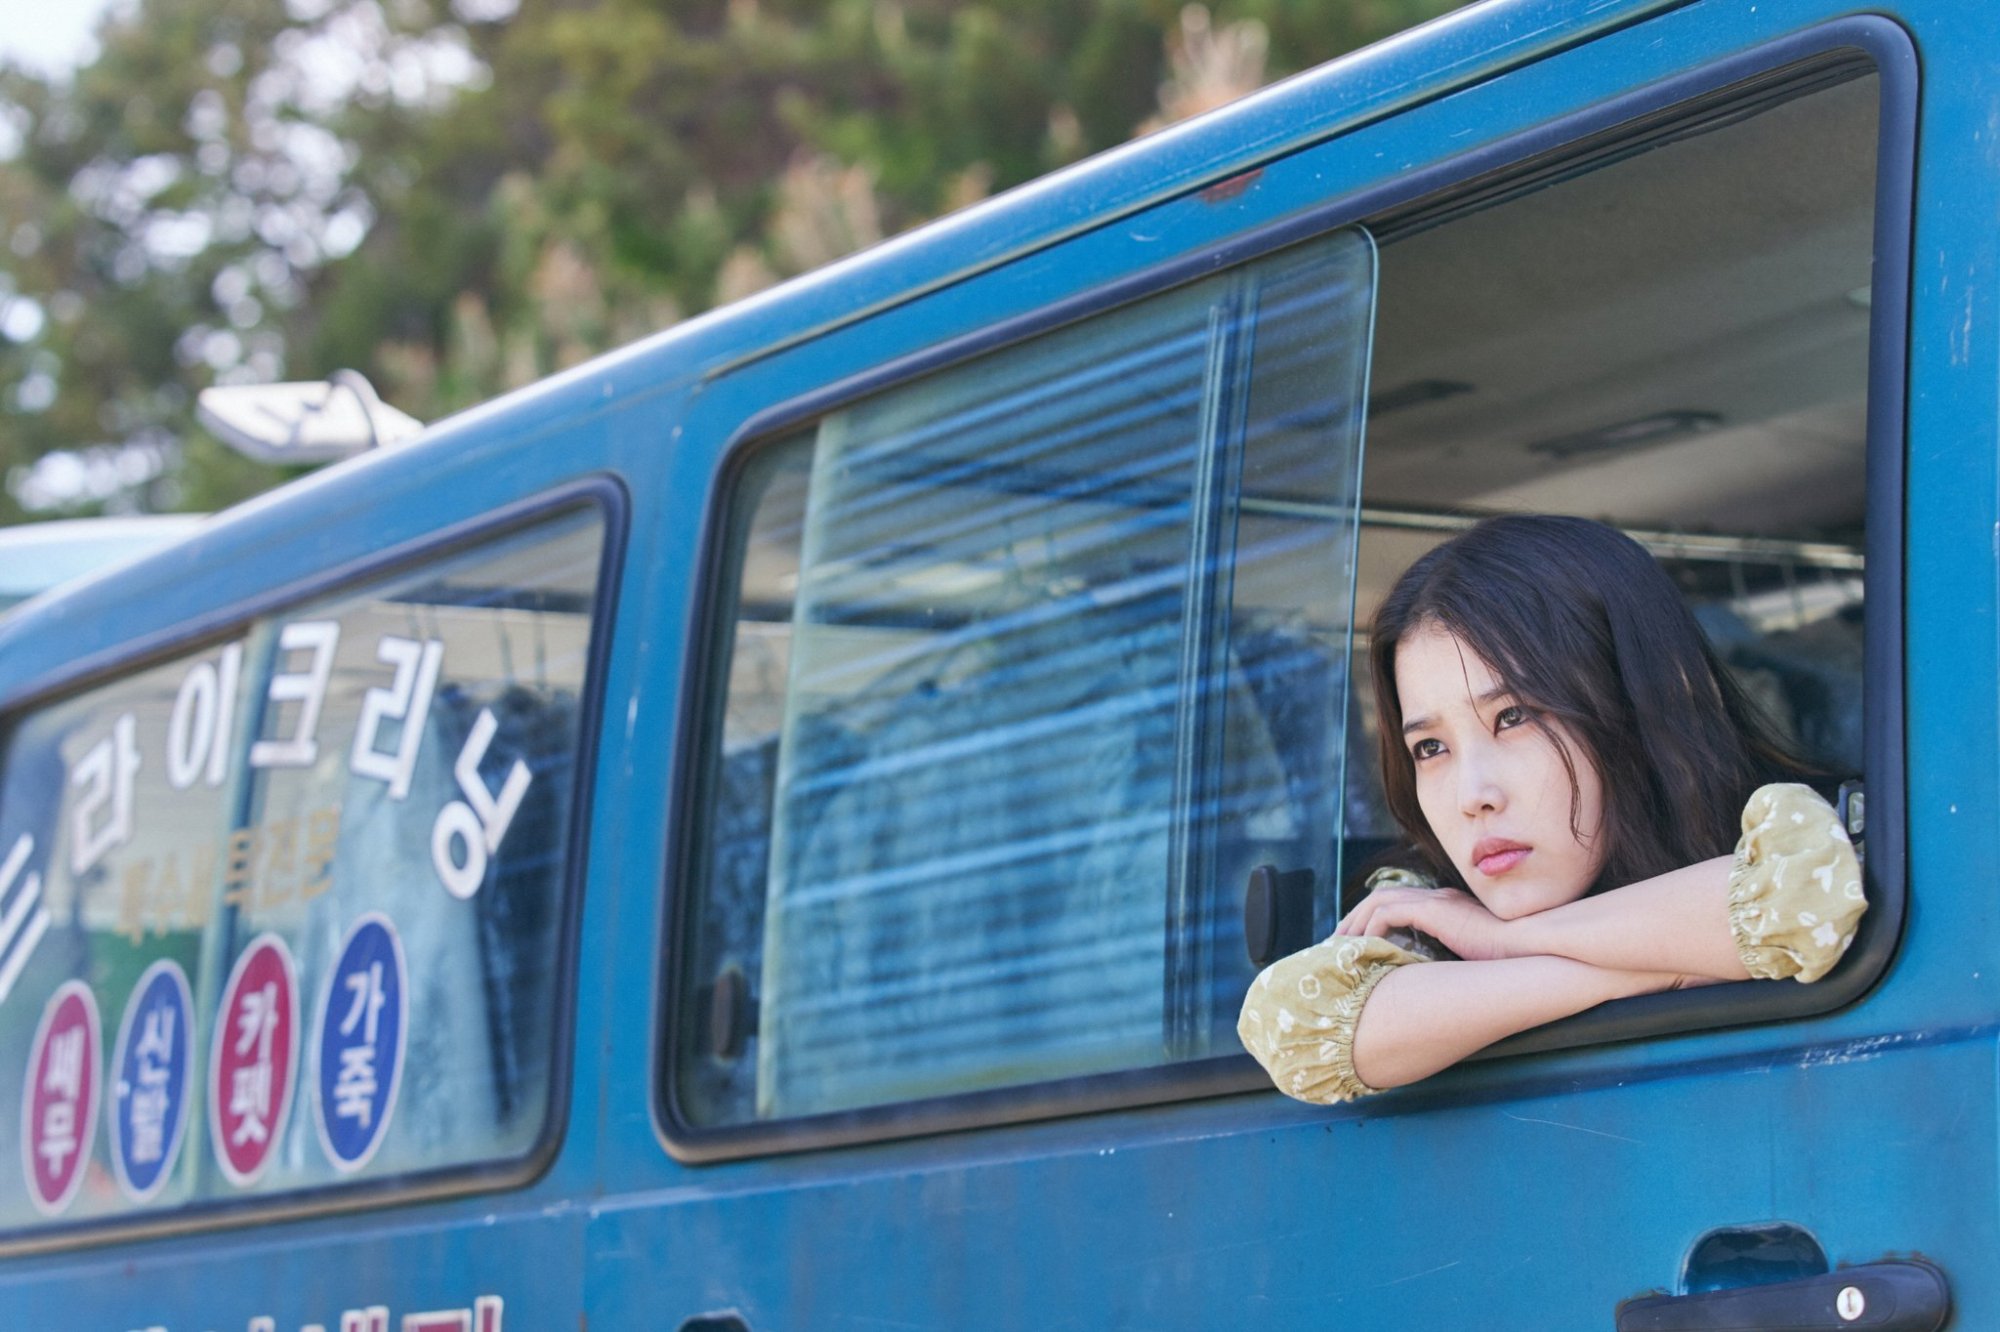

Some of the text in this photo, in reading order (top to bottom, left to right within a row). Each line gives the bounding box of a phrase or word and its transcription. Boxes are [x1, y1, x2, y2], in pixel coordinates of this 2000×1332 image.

[130, 1002, 176, 1165] 신발
[229, 980, 279, 1147] 카펫
[334, 960, 386, 1131] 가죽
